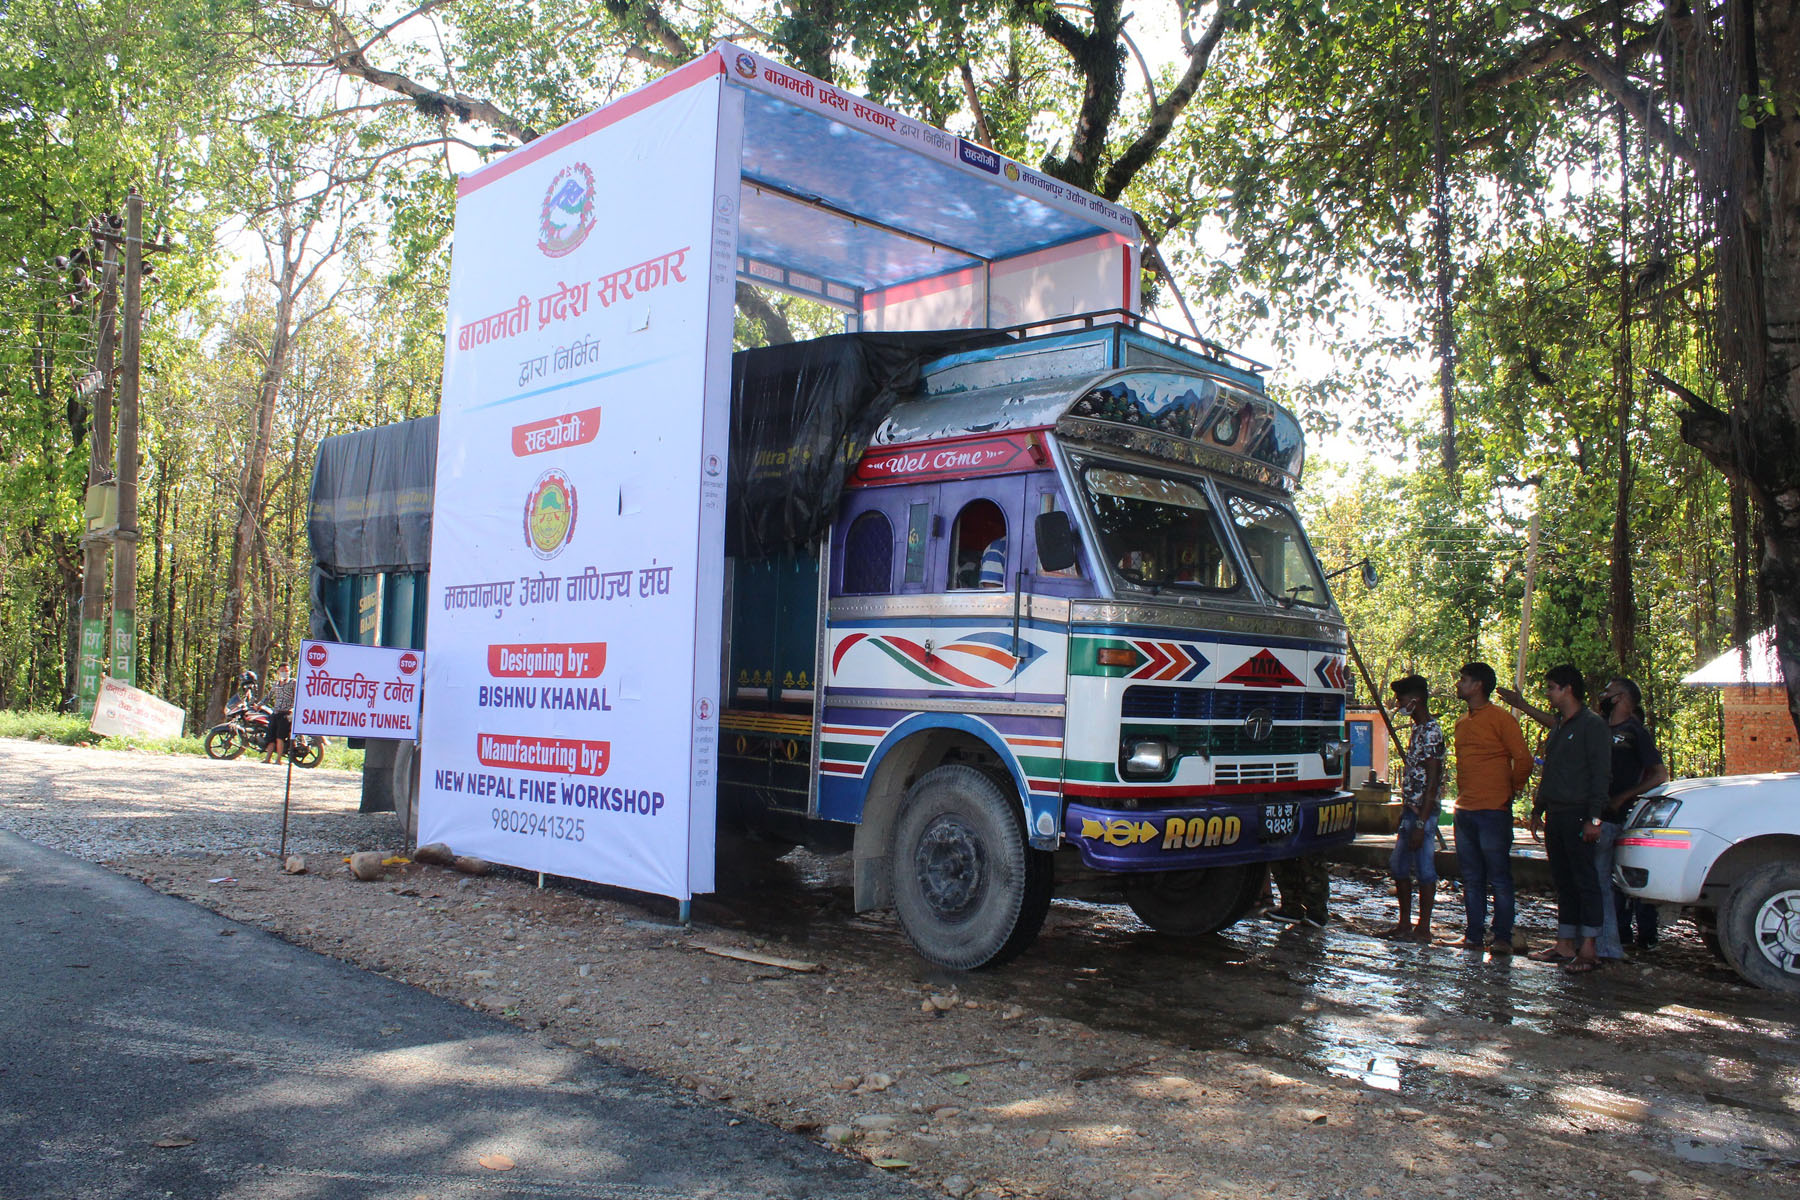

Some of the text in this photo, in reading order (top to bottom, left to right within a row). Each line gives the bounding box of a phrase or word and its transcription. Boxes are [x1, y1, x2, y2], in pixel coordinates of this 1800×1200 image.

[764, 67, 814, 98] बागमती
[819, 89, 849, 112] प्रदेश
[853, 102, 897, 132] सरकार
[458, 295, 532, 352] बागमती
[538, 281, 591, 331] प्रदेश
[598, 246, 691, 308] सरकार
[518, 333, 601, 387] द्वारा निर्मित
[886, 450, 983, 474] Wel Come
[444, 558, 673, 619] मकवानपुर उद्योग वाणिज्य संघ
[308, 652, 326, 661] STOP
[400, 660, 416, 668] STOP
[500, 648, 589, 677] Designing by:
[1250, 656, 1282, 675] TATA
[384, 676, 415, 703] टनेल
[479, 686, 612, 711] BISHNU KHANAL
[302, 709, 412, 730] SANITIZING TUNNEL
[481, 737, 603, 772] Manufacturing by:
[435, 769, 665, 816] NEW NEPAL FINE WORKSHOP
[491, 808, 585, 842] 9802941325
[1162, 802, 1353, 849] ROAD KING
